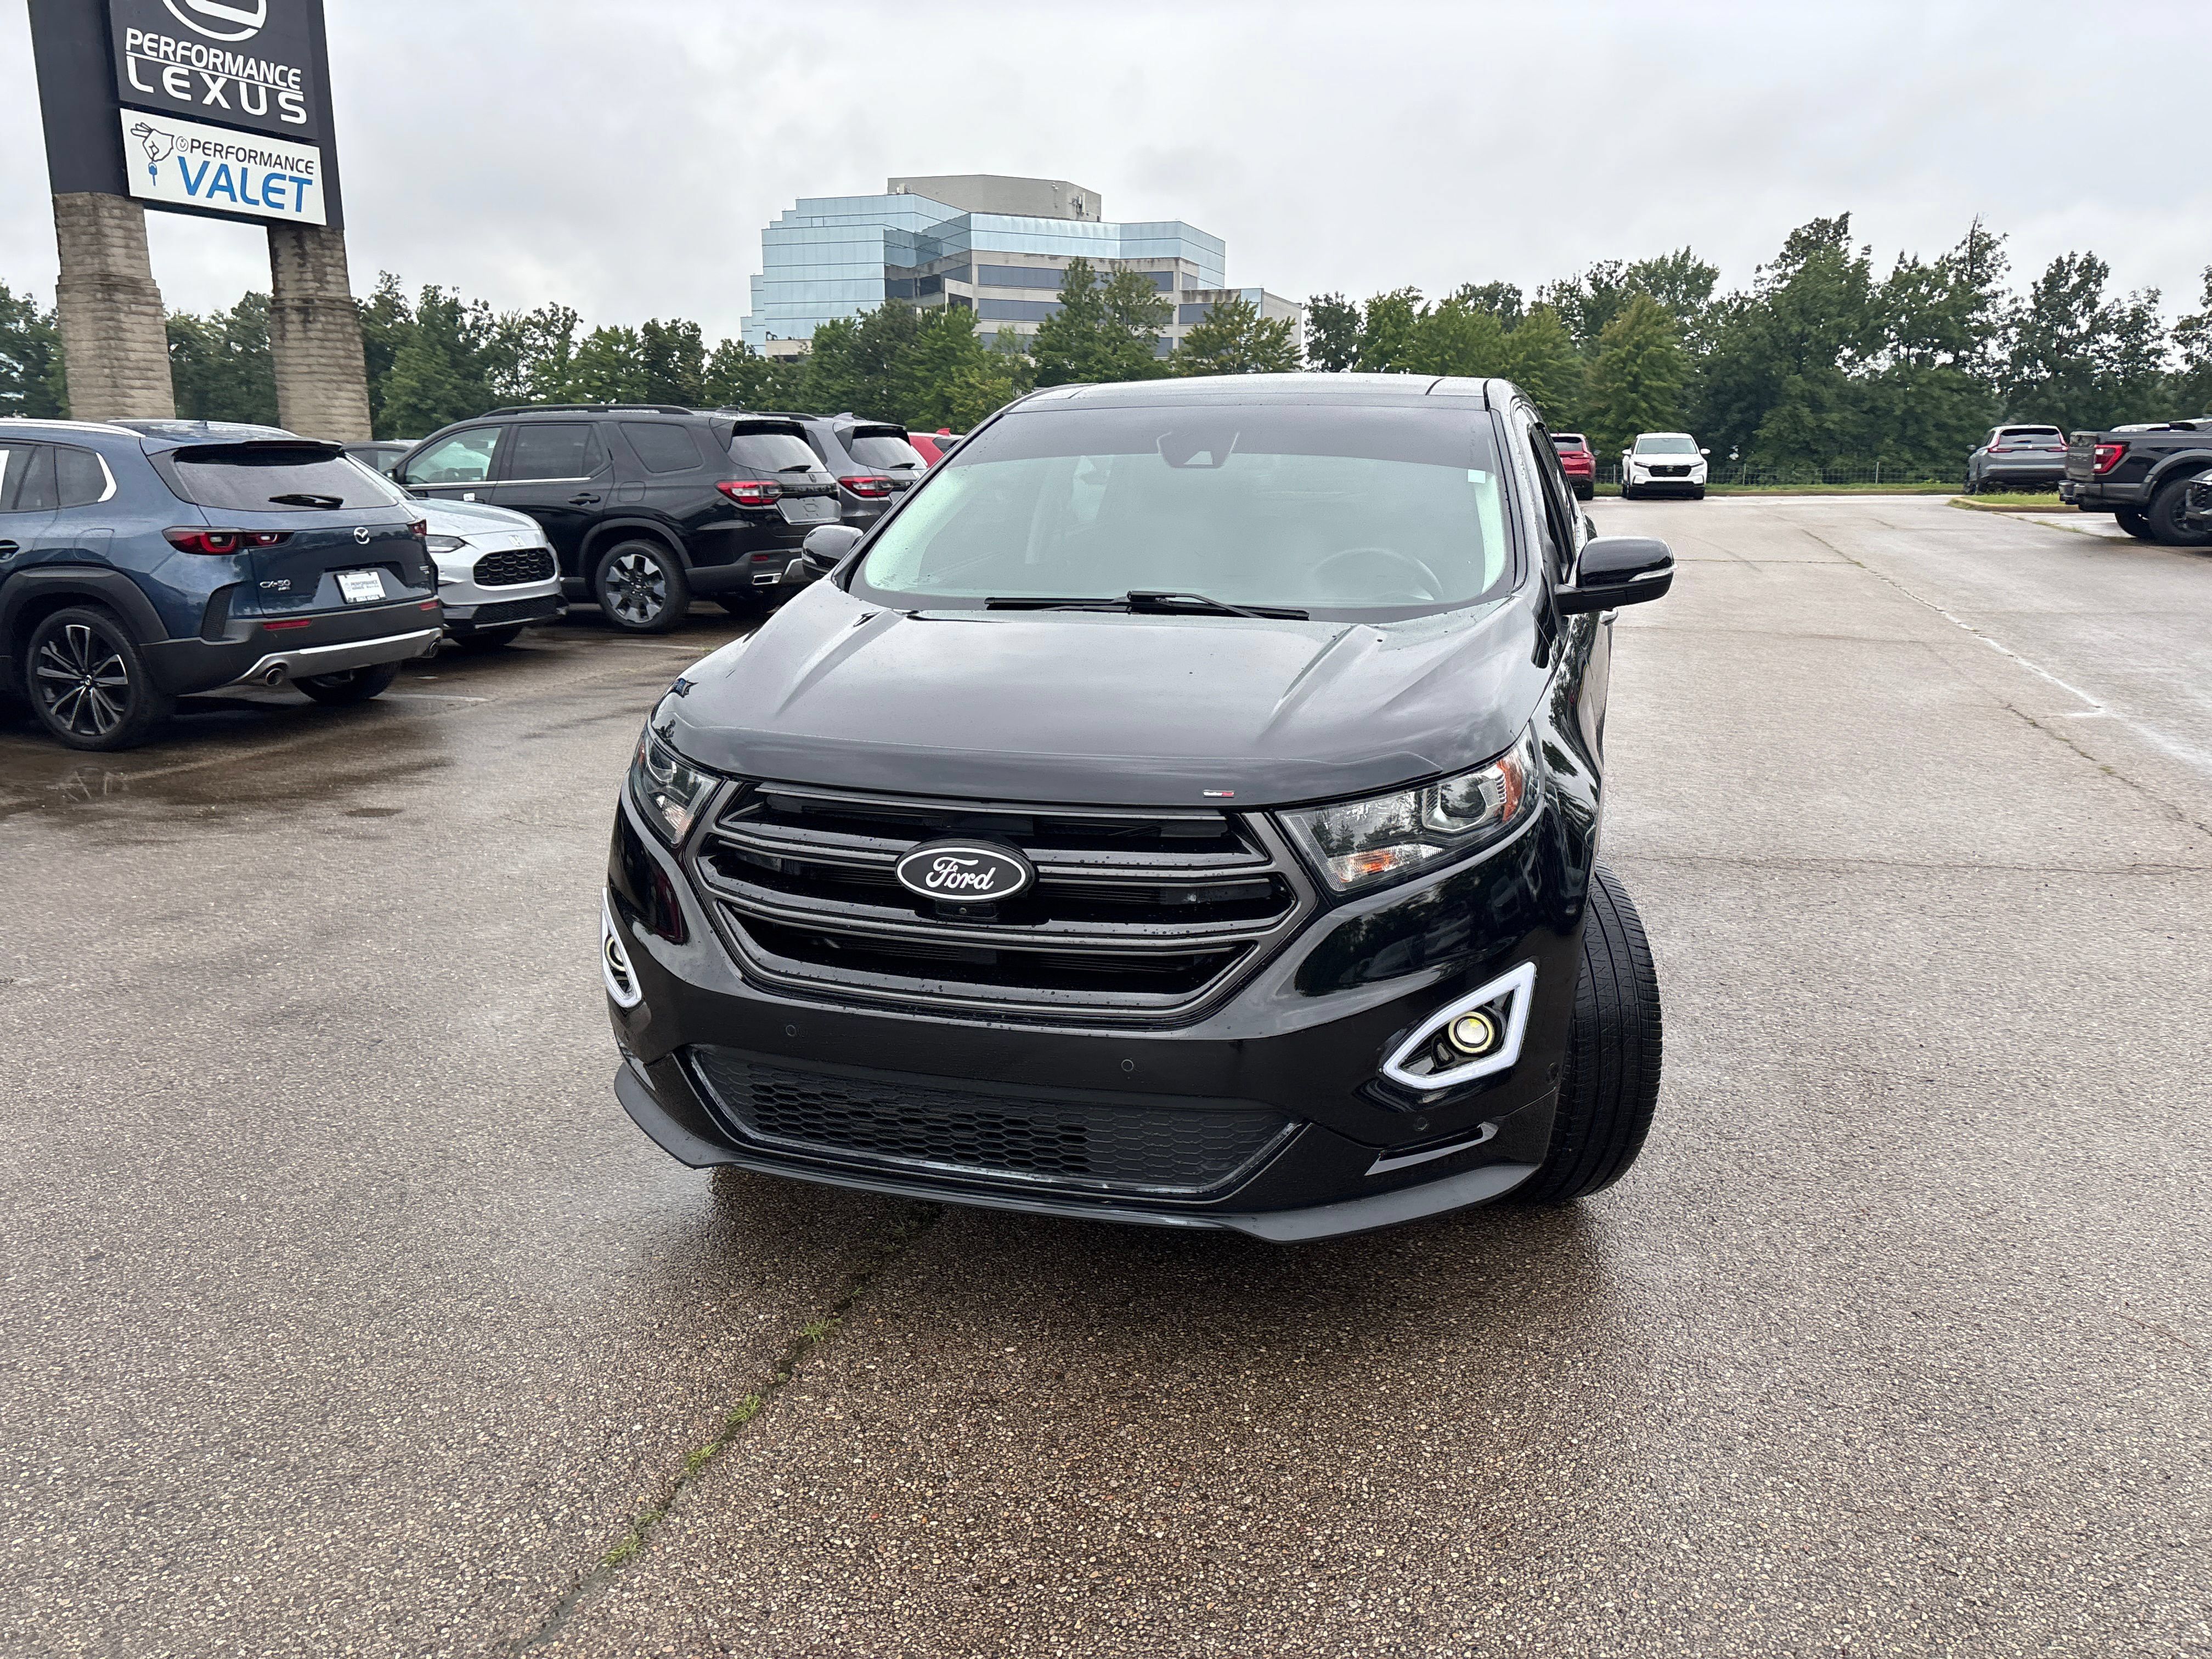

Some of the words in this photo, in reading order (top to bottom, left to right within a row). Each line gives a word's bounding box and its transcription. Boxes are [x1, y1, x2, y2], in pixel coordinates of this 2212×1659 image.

[126, 27, 301, 90] PERFORMANCE
[126, 55, 307, 125] LEXUS
[177, 155, 313, 213] VALET
[190, 138, 314, 175] PERFORMANCE
[926, 856, 996, 890] Ford
